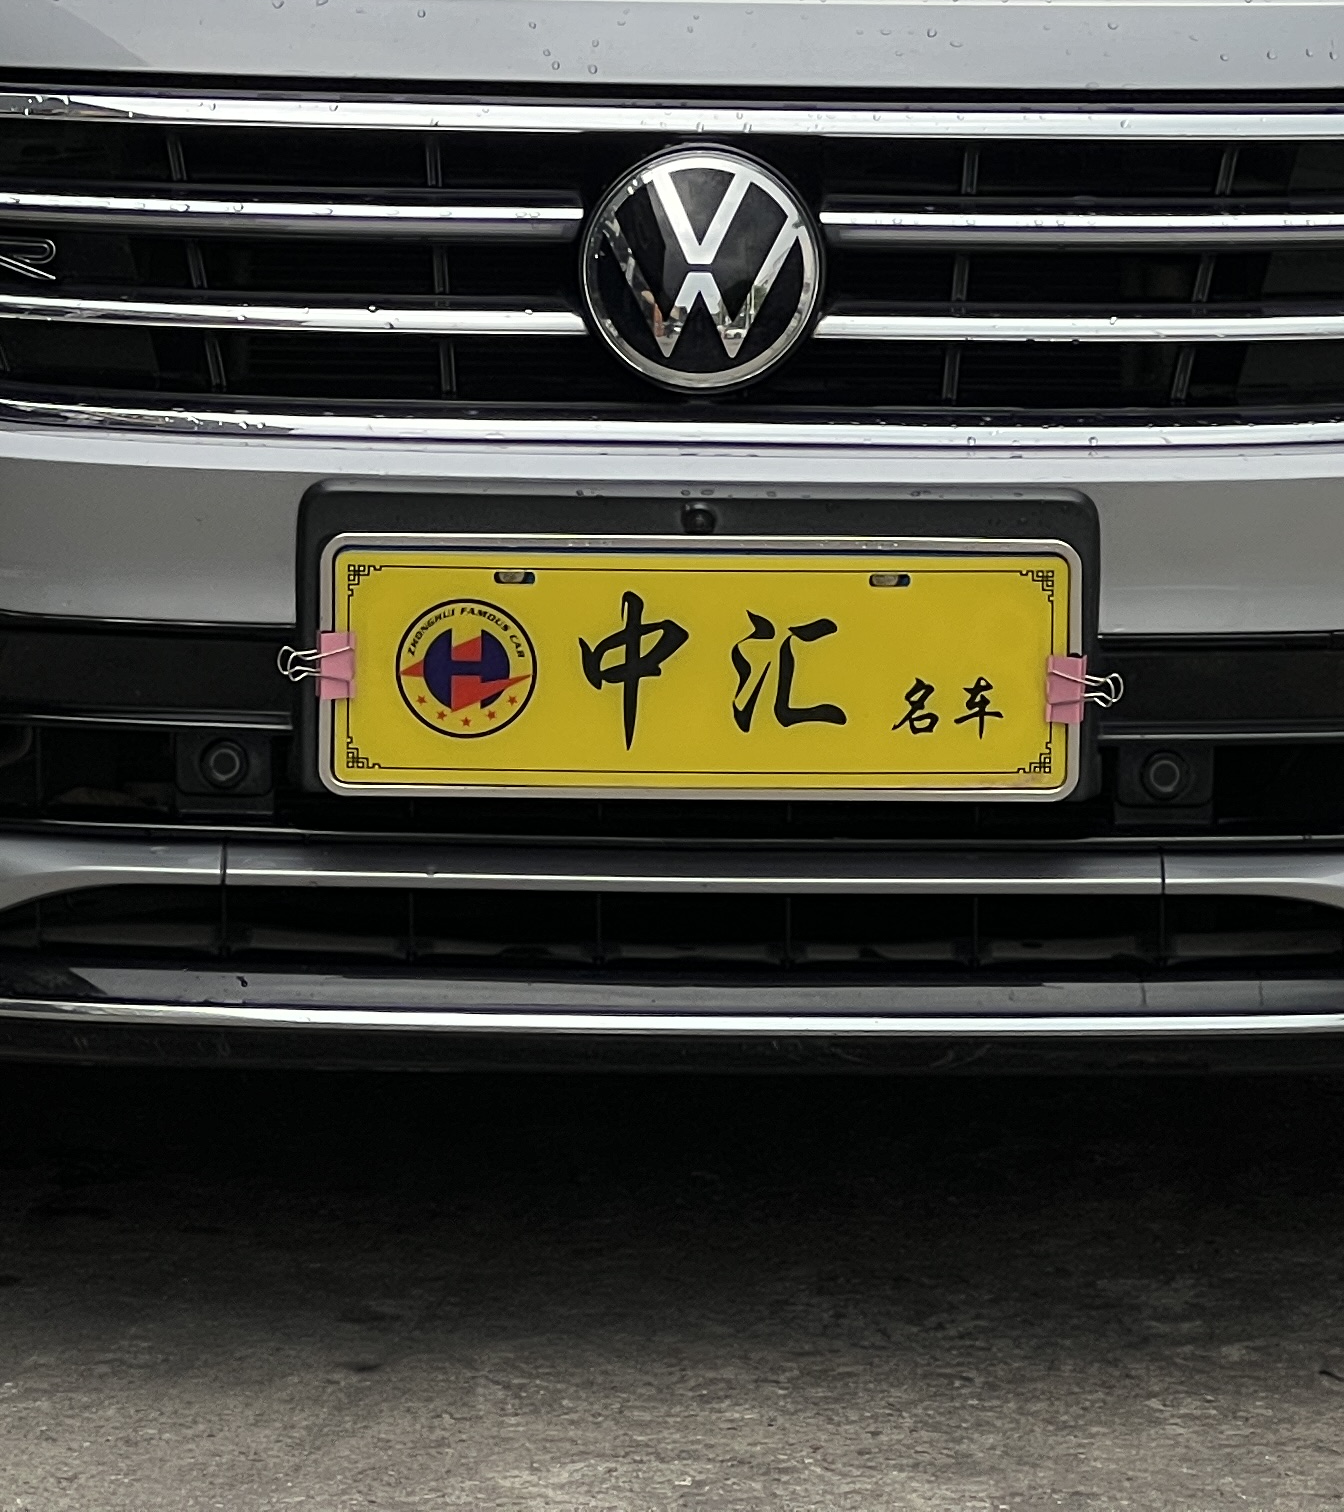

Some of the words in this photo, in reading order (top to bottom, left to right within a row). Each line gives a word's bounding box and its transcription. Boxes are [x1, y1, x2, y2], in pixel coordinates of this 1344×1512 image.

[406, 607, 456, 657] ZHONGHUI
[459, 607, 511, 633] FAMOUS
[509, 633, 526, 658] CAR
[579, 590, 847, 751] 中汇
[891, 677, 1004, 740] 名车
